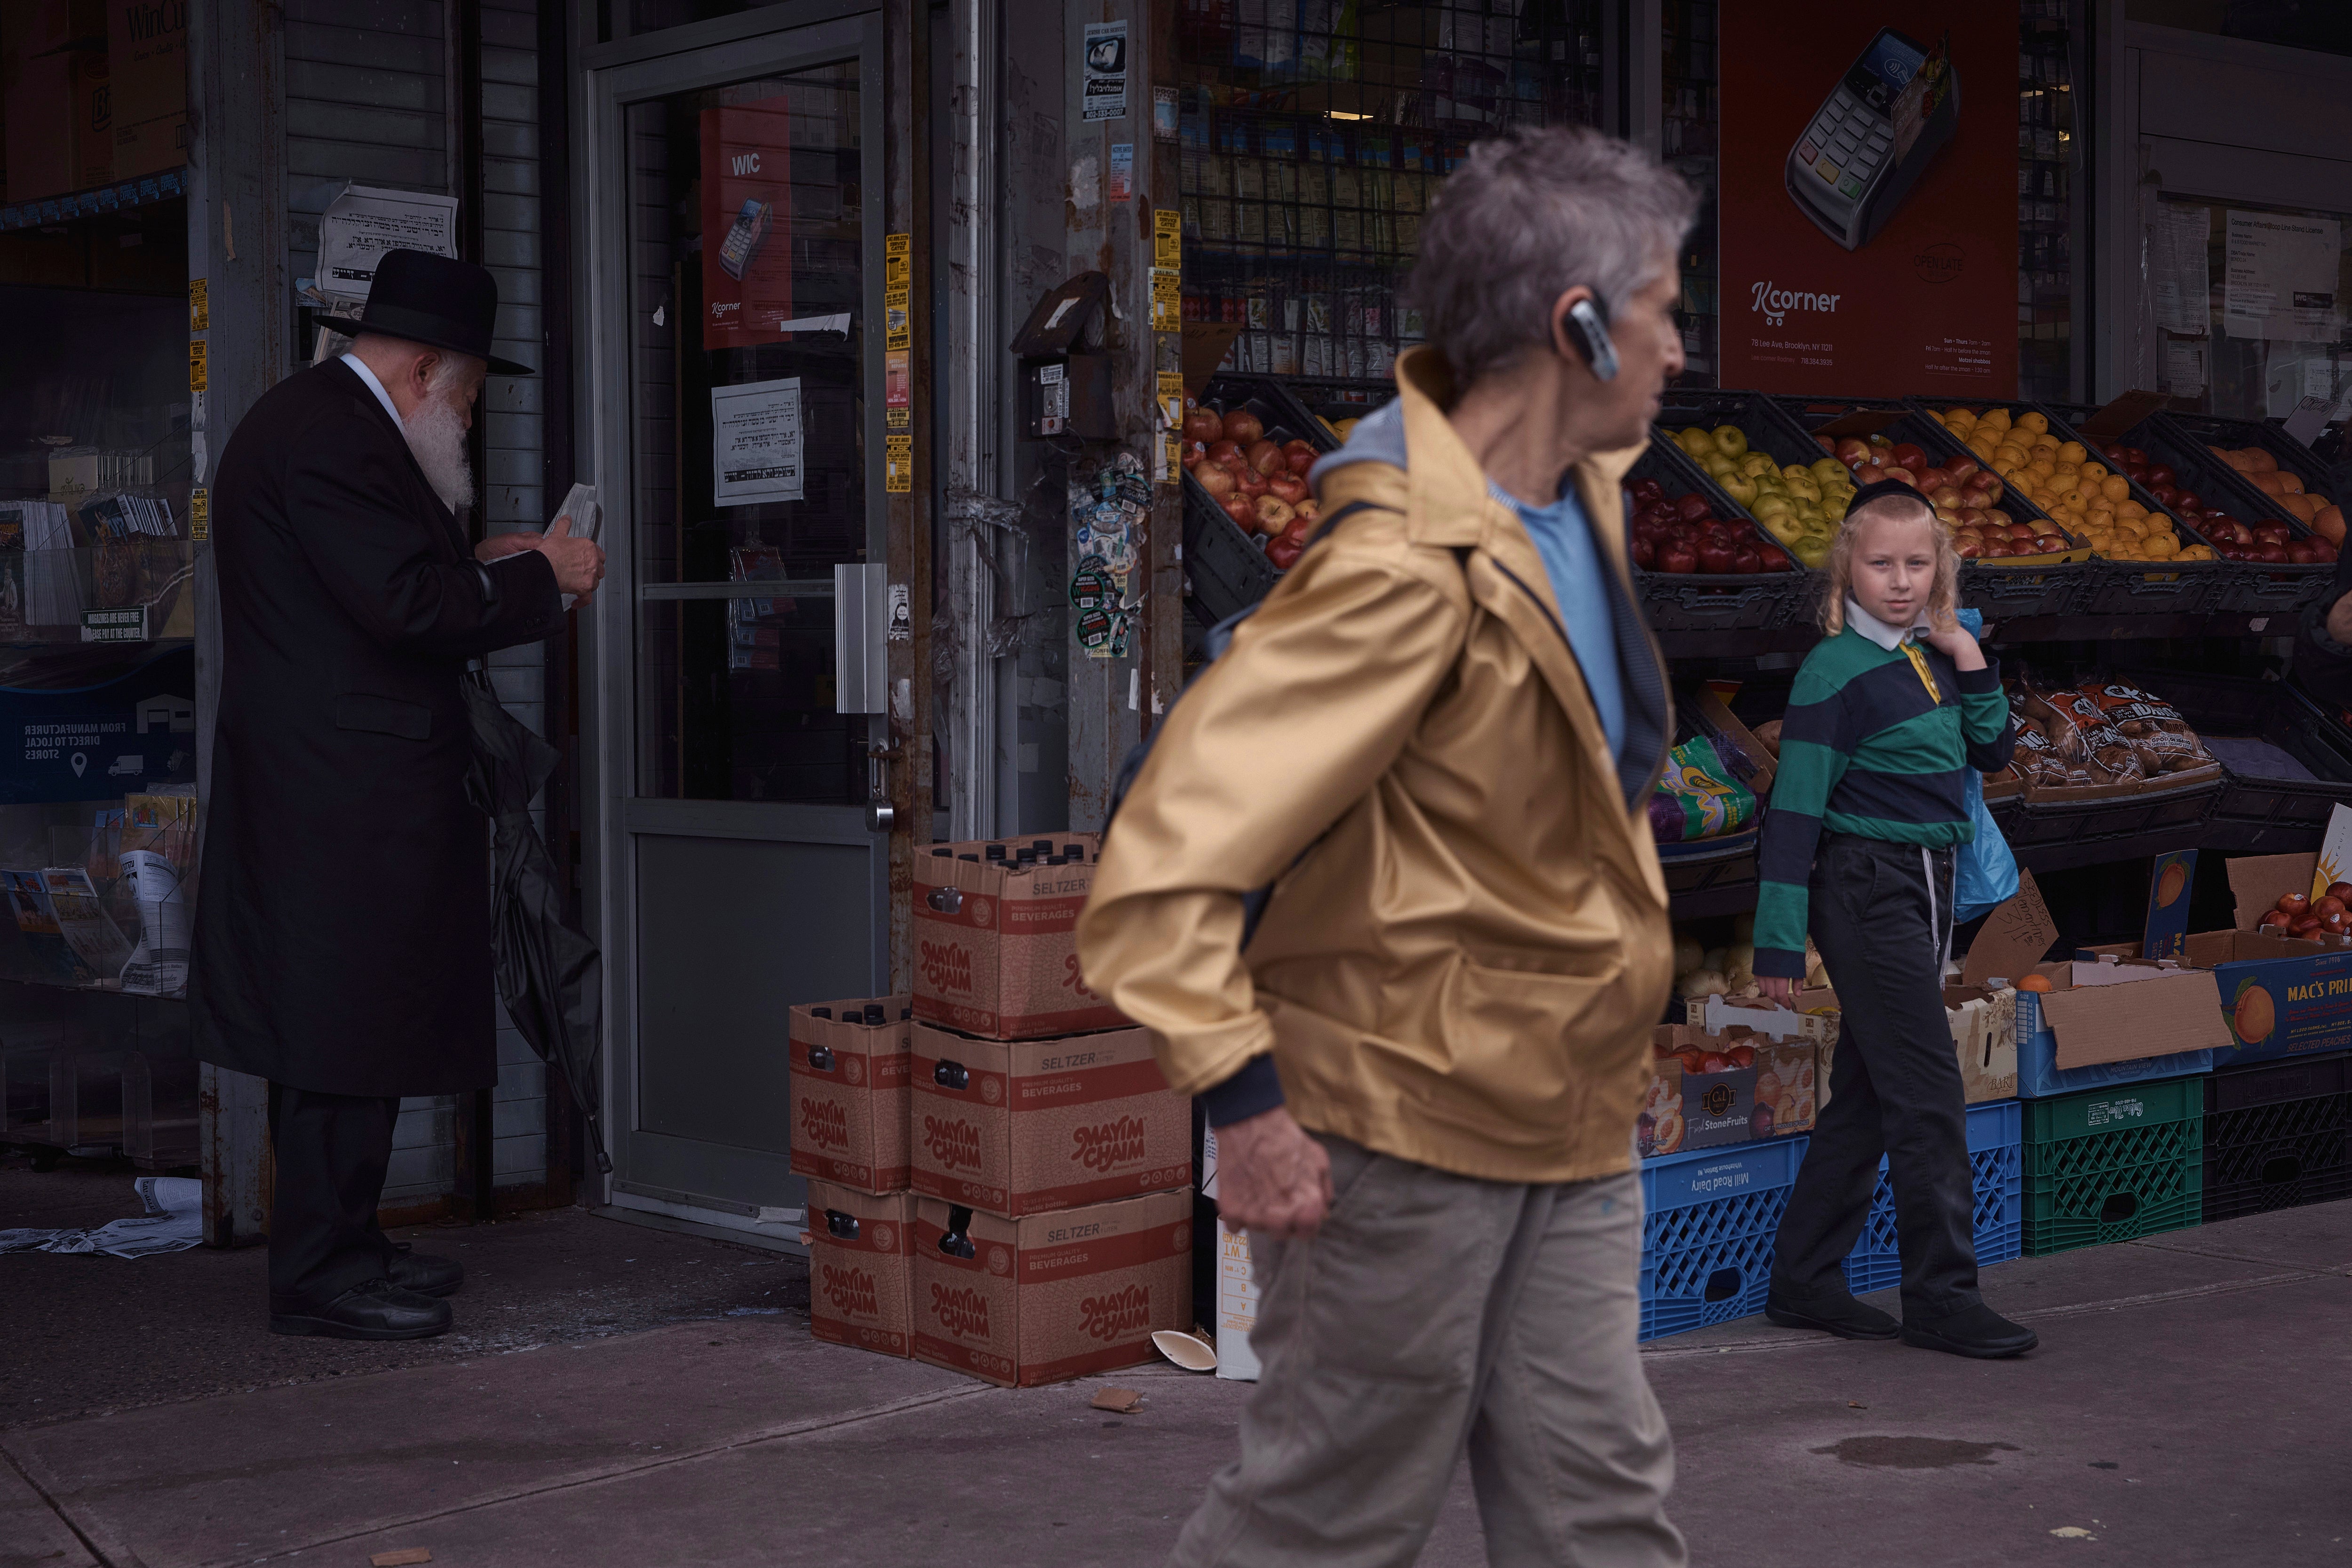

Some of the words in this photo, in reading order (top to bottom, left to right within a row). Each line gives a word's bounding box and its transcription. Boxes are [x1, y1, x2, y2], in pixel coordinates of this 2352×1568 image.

[732, 152, 760, 176] WIC
[2231, 218, 2252, 227] Consumer
[1914, 255, 1939, 269] OPEN
[1941, 258, 1963, 271] LATE
[1751, 280, 1840, 318] Kcorner
[712, 302, 741, 315] Kcorner
[1771, 341, 1784, 349] Ave,
[1785, 342, 1811, 352] Brooklyn,
[88, 613, 109, 624] MAGAZINES
[118, 612, 129, 622] NEVER
[130, 612, 139, 622] FREE
[92, 629, 101, 639] EASE
[110, 629, 115, 638] AT
[124, 628, 141, 638] COUNTER.
[2130, 702, 2177, 718] IDAHO
[1033, 879, 1085, 895] SELTZER
[2024, 877, 2051, 926] SEEDLESS
[1011, 910, 1074, 922] BEVERAGES
[921, 939, 970, 971] MAYIM
[927, 965, 971, 993] CHAIM
[2288, 981, 2324, 1002] MAC'S
[1033, 1026, 1058, 1035] bottles
[2287, 1039, 2320, 1052] SELECTED
[2321, 1035, 2351, 1047] PEACHES
[1042, 1054, 1095, 1070] SELTZER
[2111, 1063, 2137, 1073] MOUNTAIN
[1022, 1082, 1081, 1097] BEVERAGES
[1991, 1075, 2013, 1090] BARI
[801, 1098, 846, 1128] MAYIM
[2109, 1106, 2123, 1119] Flow
[2123, 1102, 2143, 1116] Golden
[808, 1120, 848, 1149] CHAIM
[925, 1115, 981, 1146] MAYIM
[1687, 1118, 1705, 1140] Fresh
[1705, 1115, 1748, 1129] StoneFruits
[1072, 1115, 1144, 1160] MAYIM
[932, 1136, 981, 1169] CHAIM
[1083, 1138, 1144, 1172] CHAIM
[1719, 1162, 1742, 1171] Whitehouse
[1692, 1178, 1711, 1192] Dairy
[1714, 1176, 1732, 1187] Road
[1735, 1172, 1749, 1185] Mill
[1023, 1203, 1043, 1212] Plastic
[1048, 1223, 1099, 1242] SELTZER
[1030, 1252, 1056, 1261] PREMIUM
[1224, 1244, 1240, 1257] WT
[1030, 1254, 1088, 1270] BEVERAGES
[823, 1265, 874, 1294] MAYIM
[831, 1290, 878, 1315] CHAIM
[931, 1283, 987, 1316] MAYIM
[1078, 1284, 1149, 1330] MAYIM
[1241, 1302, 1246, 1311] A
[940, 1306, 989, 1337] CHAIM
[1090, 1307, 1149, 1341] CHAIM
[825, 1331, 842, 1340] bottles
[917, 1345, 930, 1354] Plastic
[932, 1349, 948, 1360] bottles
[1030, 1375, 1050, 1384] Plastic
[1051, 1370, 1074, 1381] bottles
